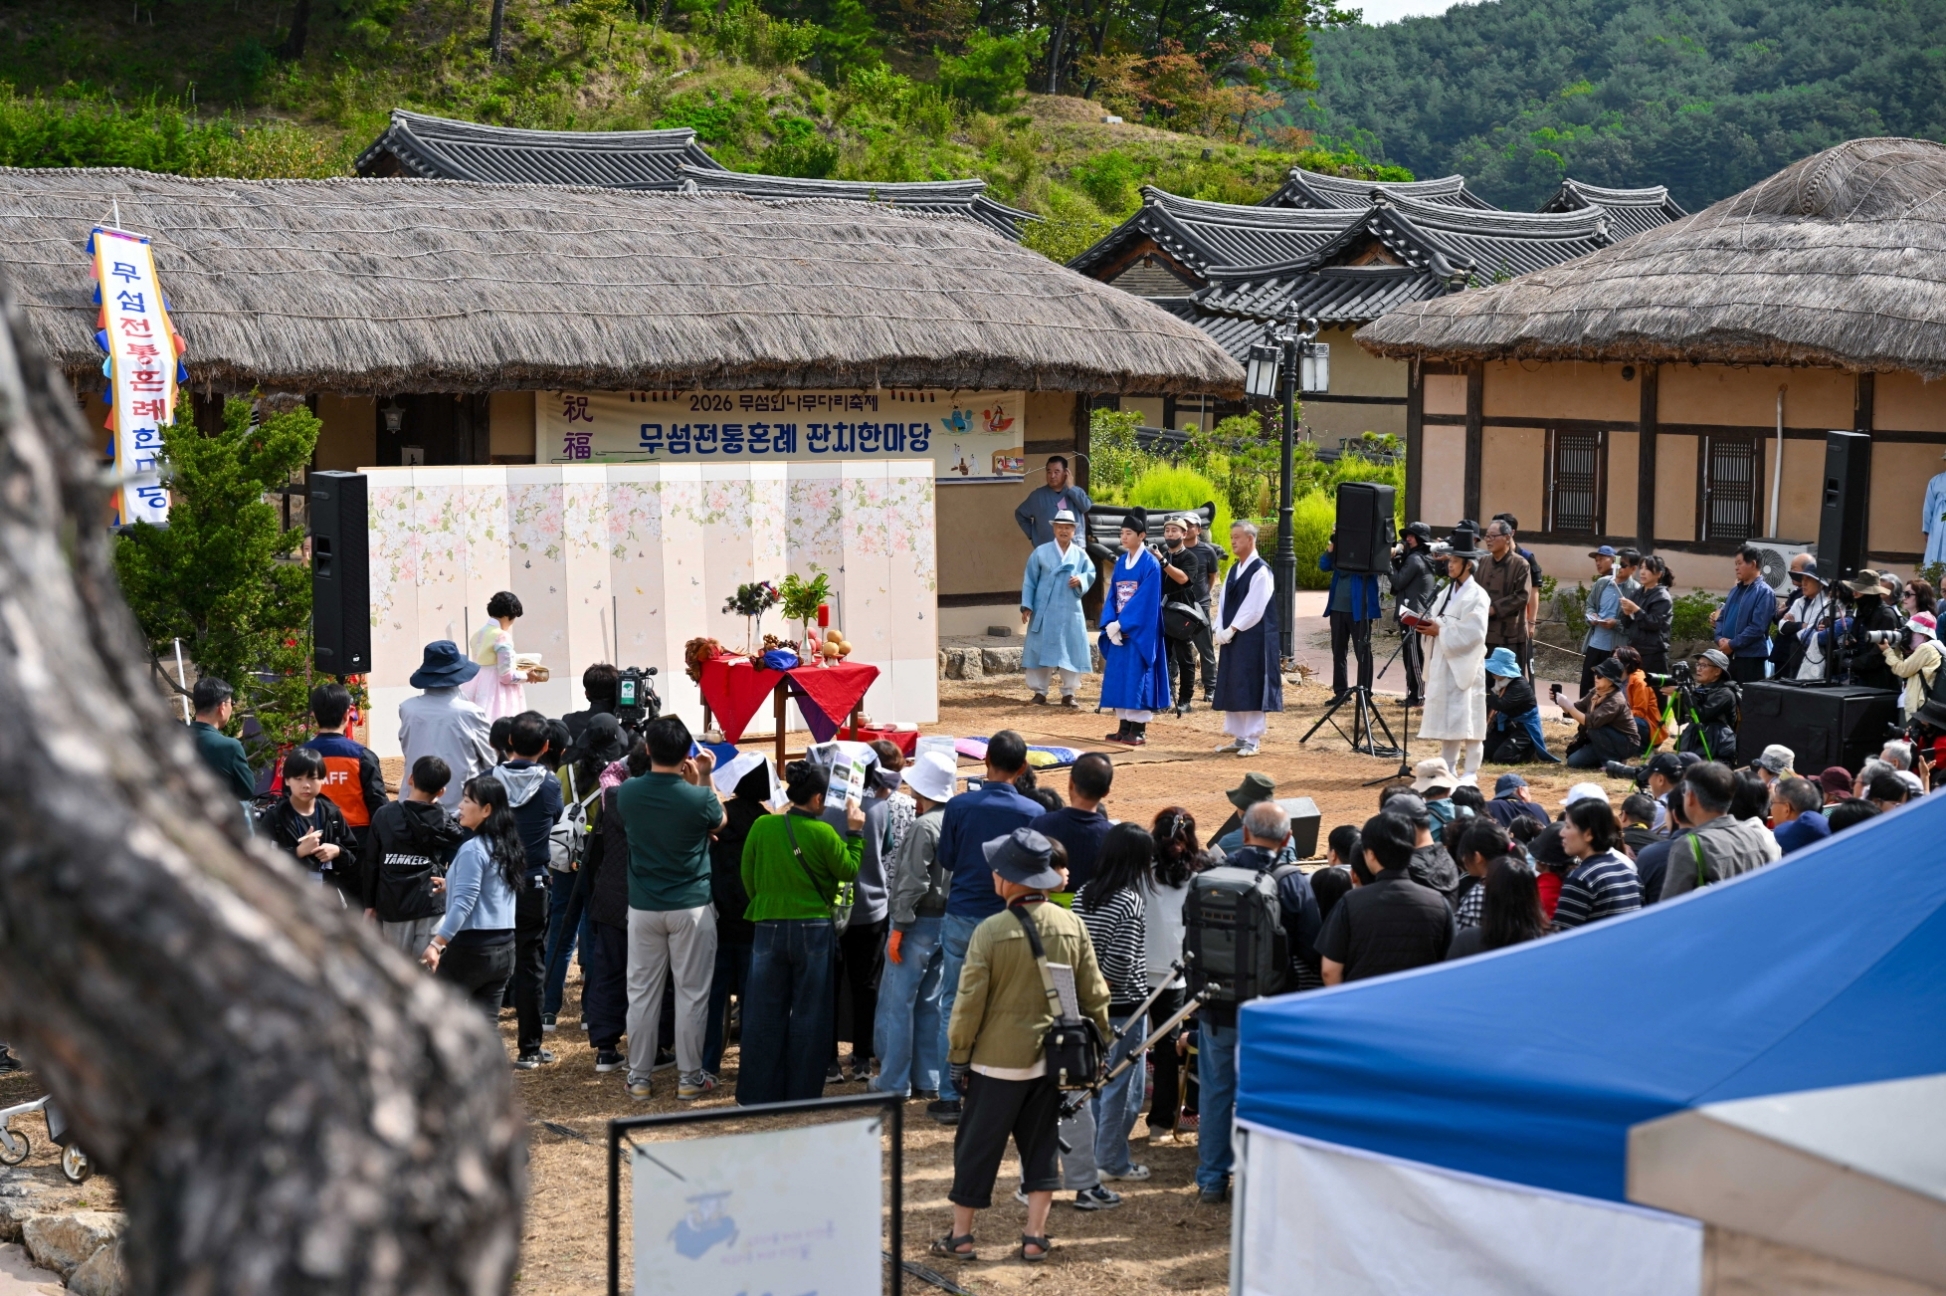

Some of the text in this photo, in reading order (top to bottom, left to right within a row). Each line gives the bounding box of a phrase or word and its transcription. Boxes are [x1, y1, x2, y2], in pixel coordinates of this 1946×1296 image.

[690, 394, 879, 412] 2026 무섬외나무다리축제
[639, 421, 932, 455] 무섬전통혼례 잔치한마당
